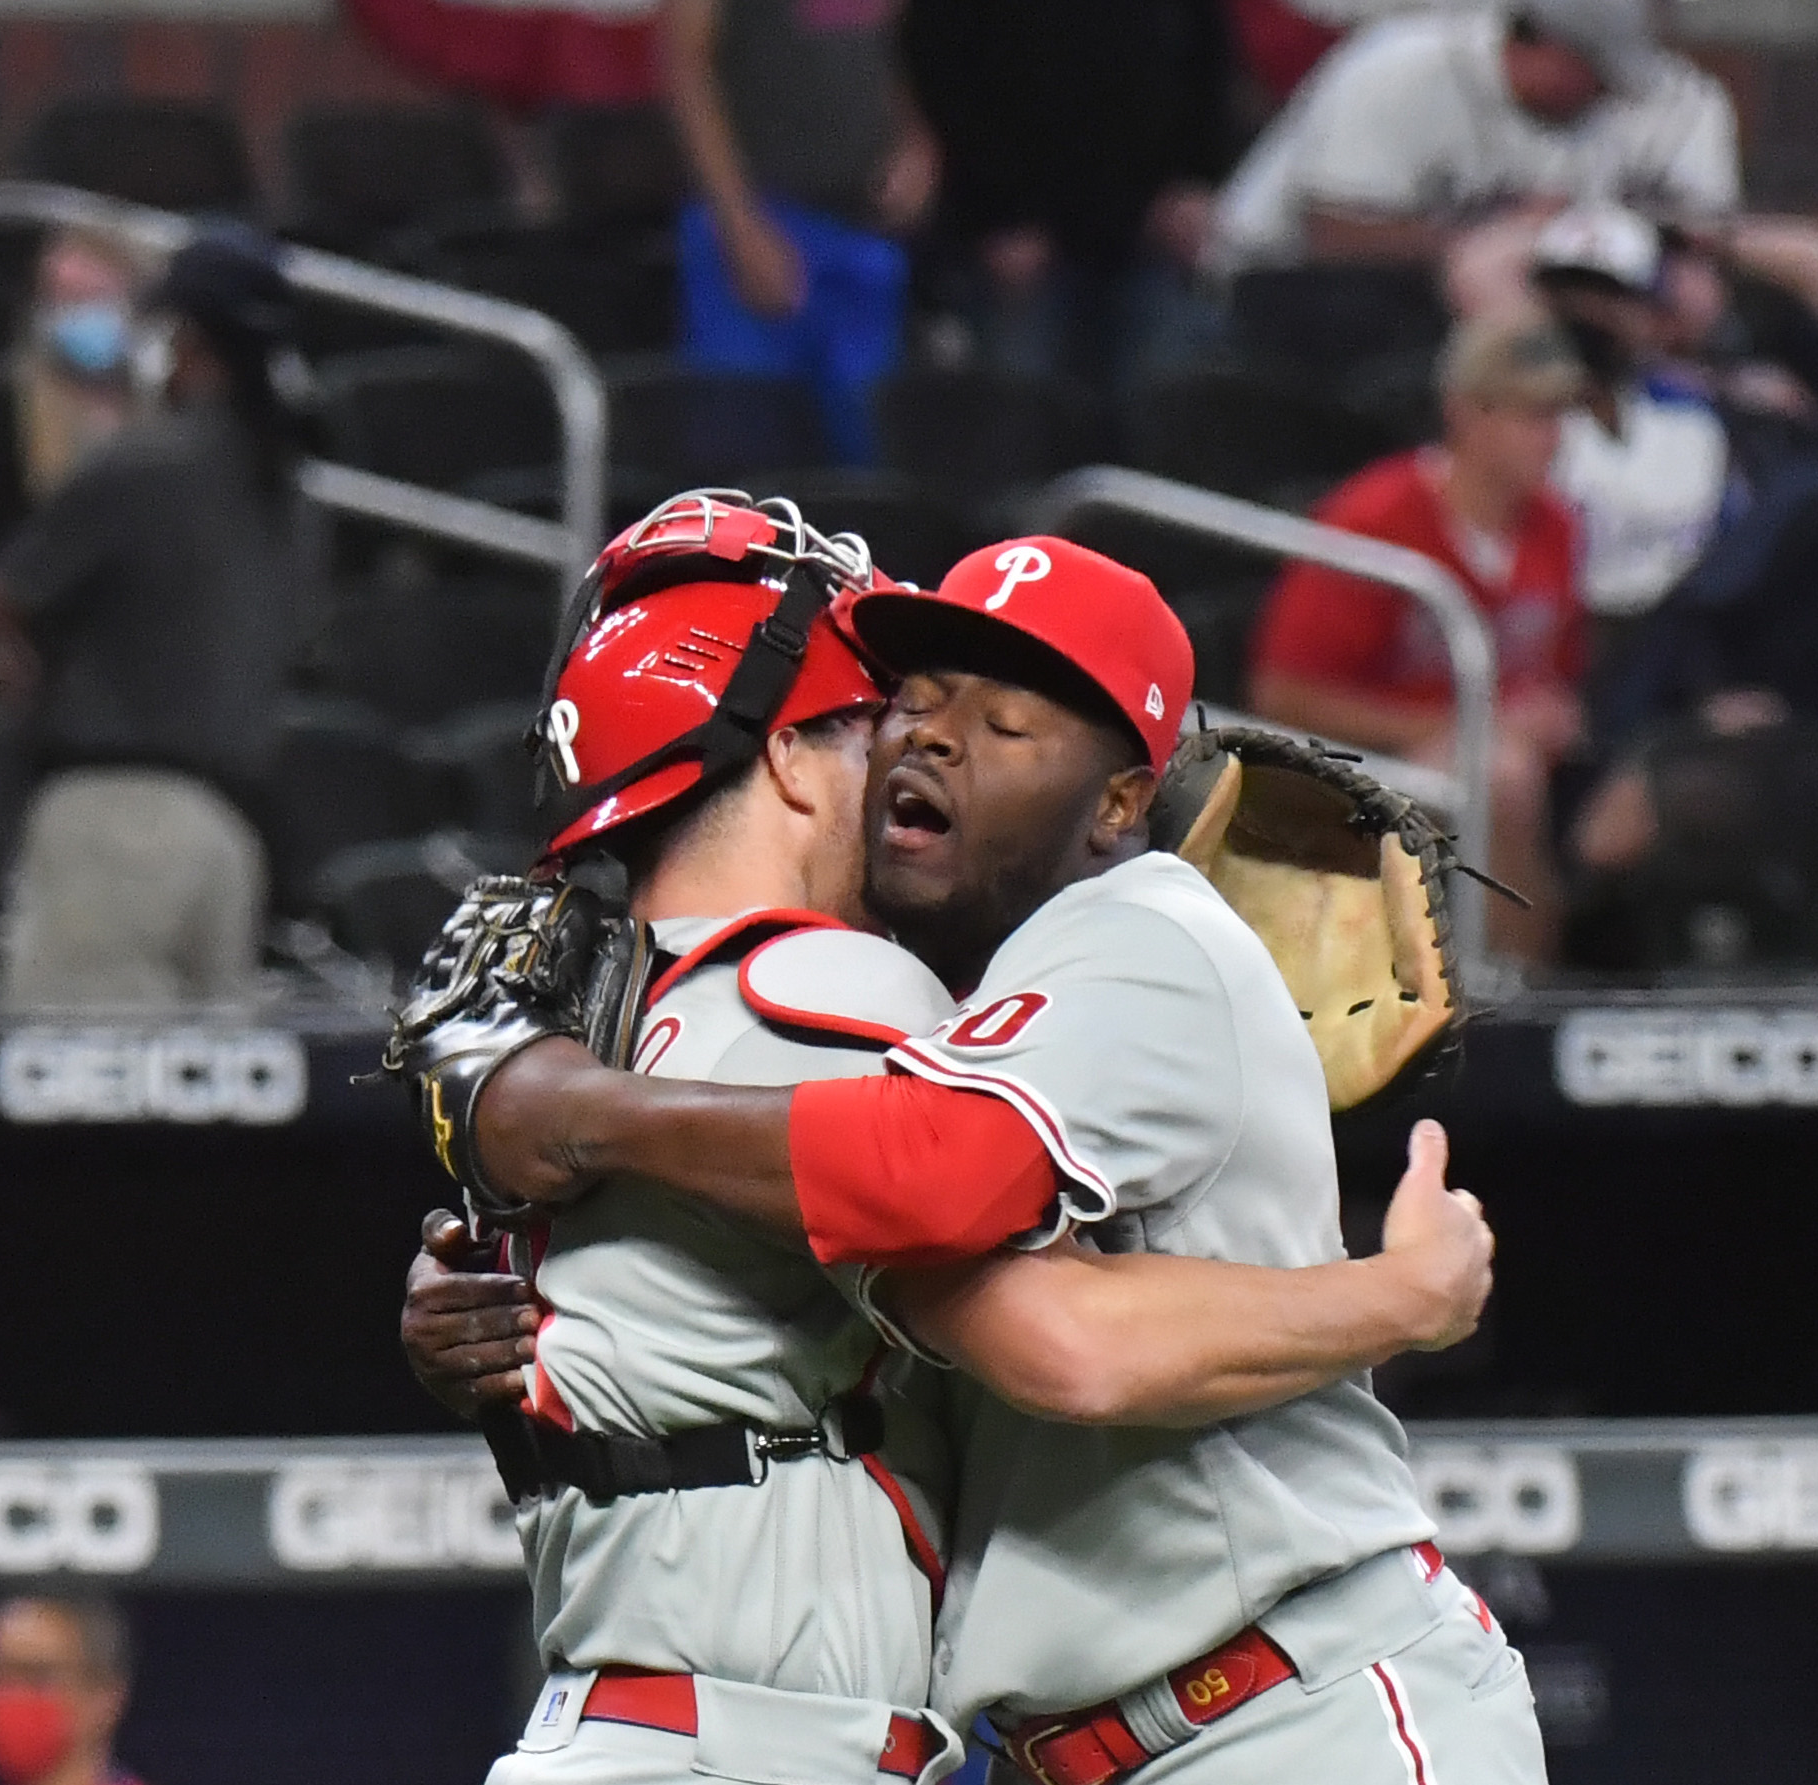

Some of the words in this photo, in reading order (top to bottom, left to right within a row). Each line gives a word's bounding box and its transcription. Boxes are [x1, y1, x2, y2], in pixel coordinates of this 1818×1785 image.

[985, 546, 1052, 611] P
[547, 699, 581, 783] P
[933, 987, 1053, 1051] 0
